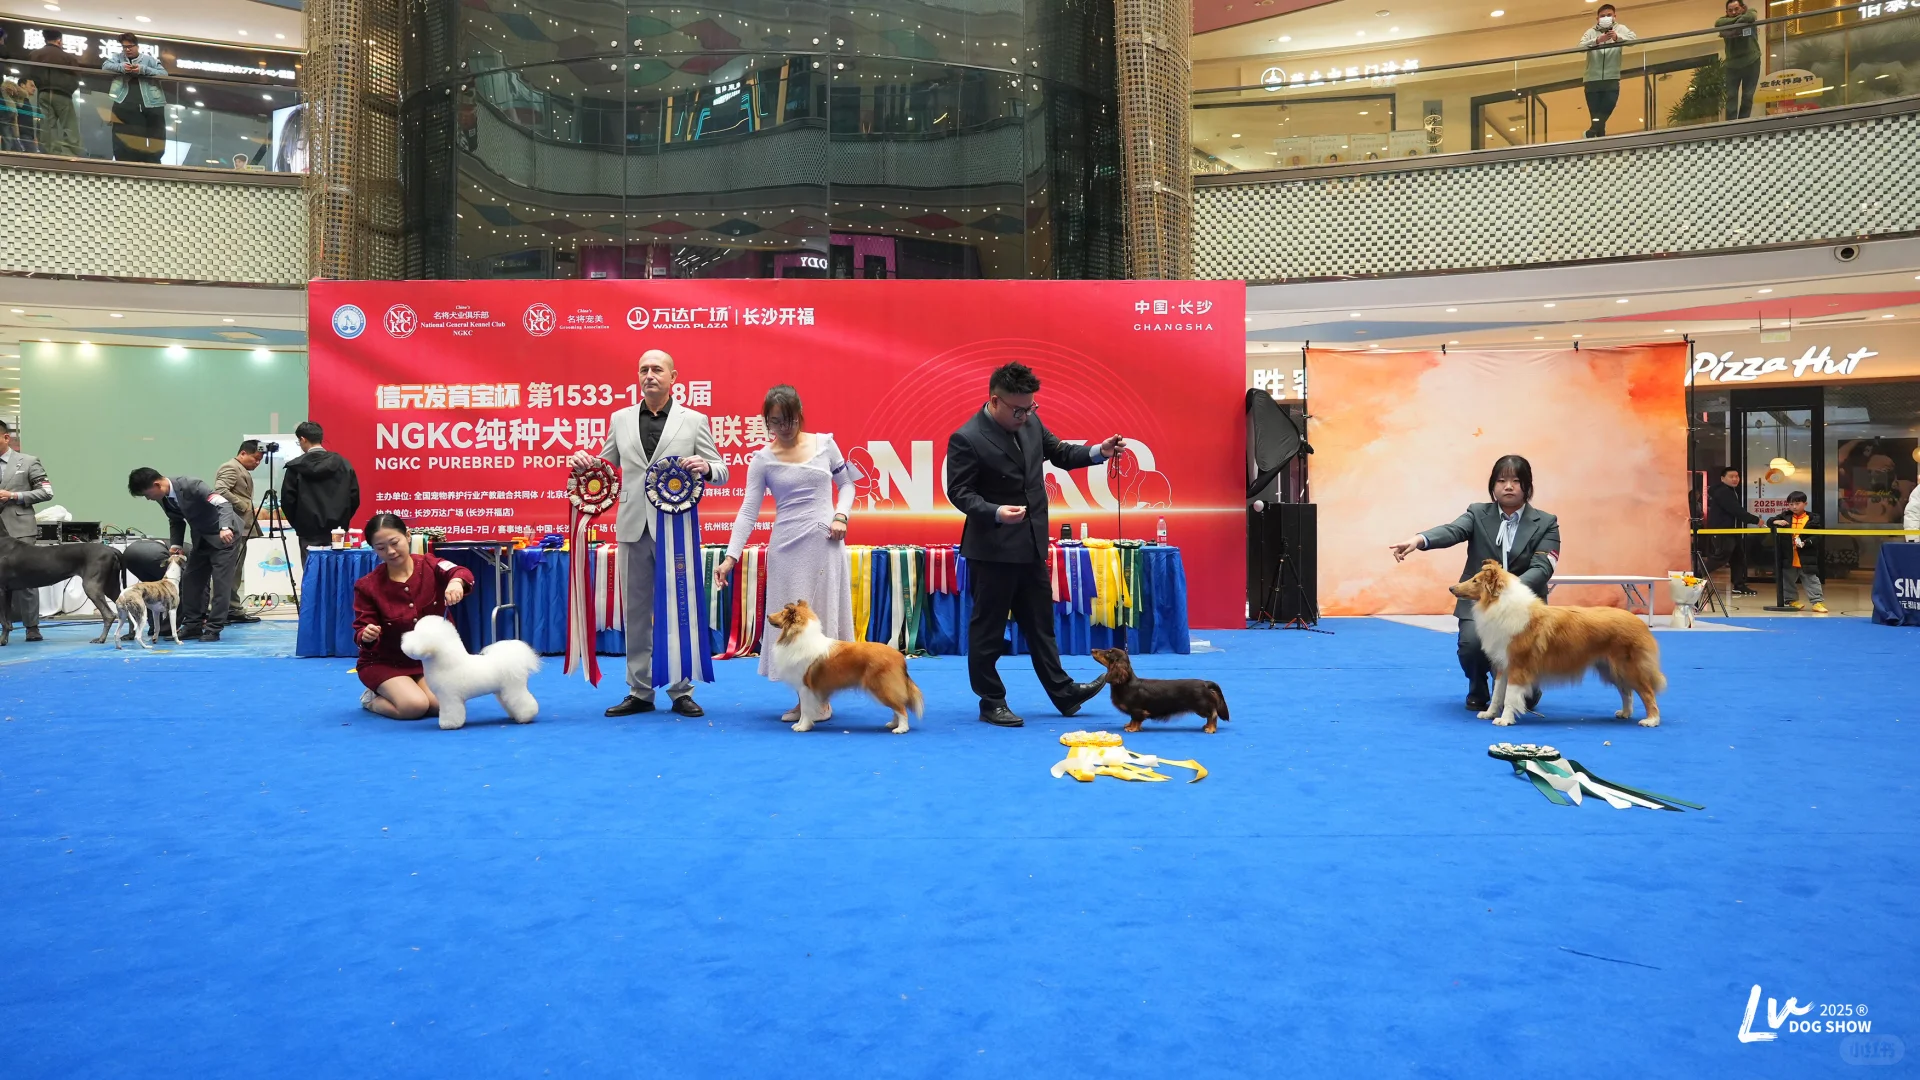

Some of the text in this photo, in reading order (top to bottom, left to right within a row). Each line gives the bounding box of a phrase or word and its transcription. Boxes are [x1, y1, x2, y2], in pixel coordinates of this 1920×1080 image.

[434, 311, 489, 320] 名将犬业俱乐部
[652, 306, 815, 326] 万达广场 长沙开福
[1133, 323, 1214, 331] CHANGSHA
[1684, 345, 1879, 387] Pizza Hut
[375, 381, 712, 409] 信元发育宝杯 第1533-18届
[376, 414, 776, 451] NGKC纯种犬职联赛
[375, 457, 421, 470] NGKC
[428, 456, 515, 469] PUREBRED
